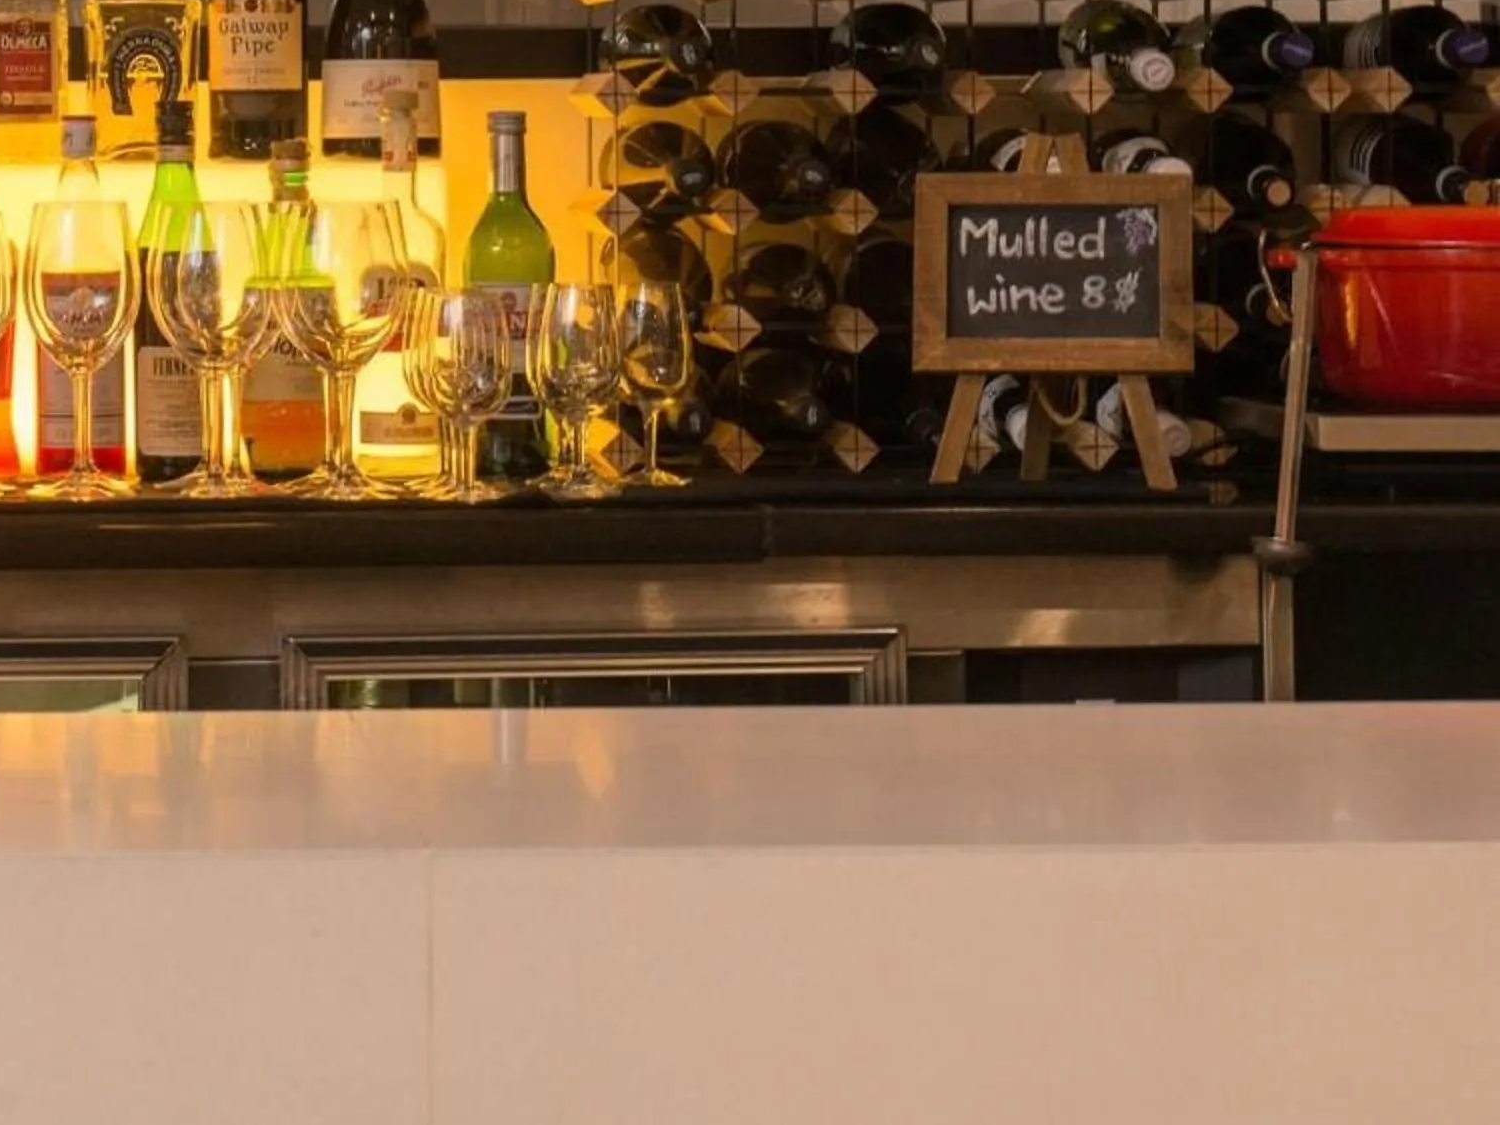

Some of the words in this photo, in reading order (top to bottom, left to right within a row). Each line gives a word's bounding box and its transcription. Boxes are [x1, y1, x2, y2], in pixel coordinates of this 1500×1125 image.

[218, 17, 290, 43] Galway
[230, 36, 276, 58] Pipe
[958, 216, 1106, 260] Mulled
[967, 273, 1066, 316] wine
